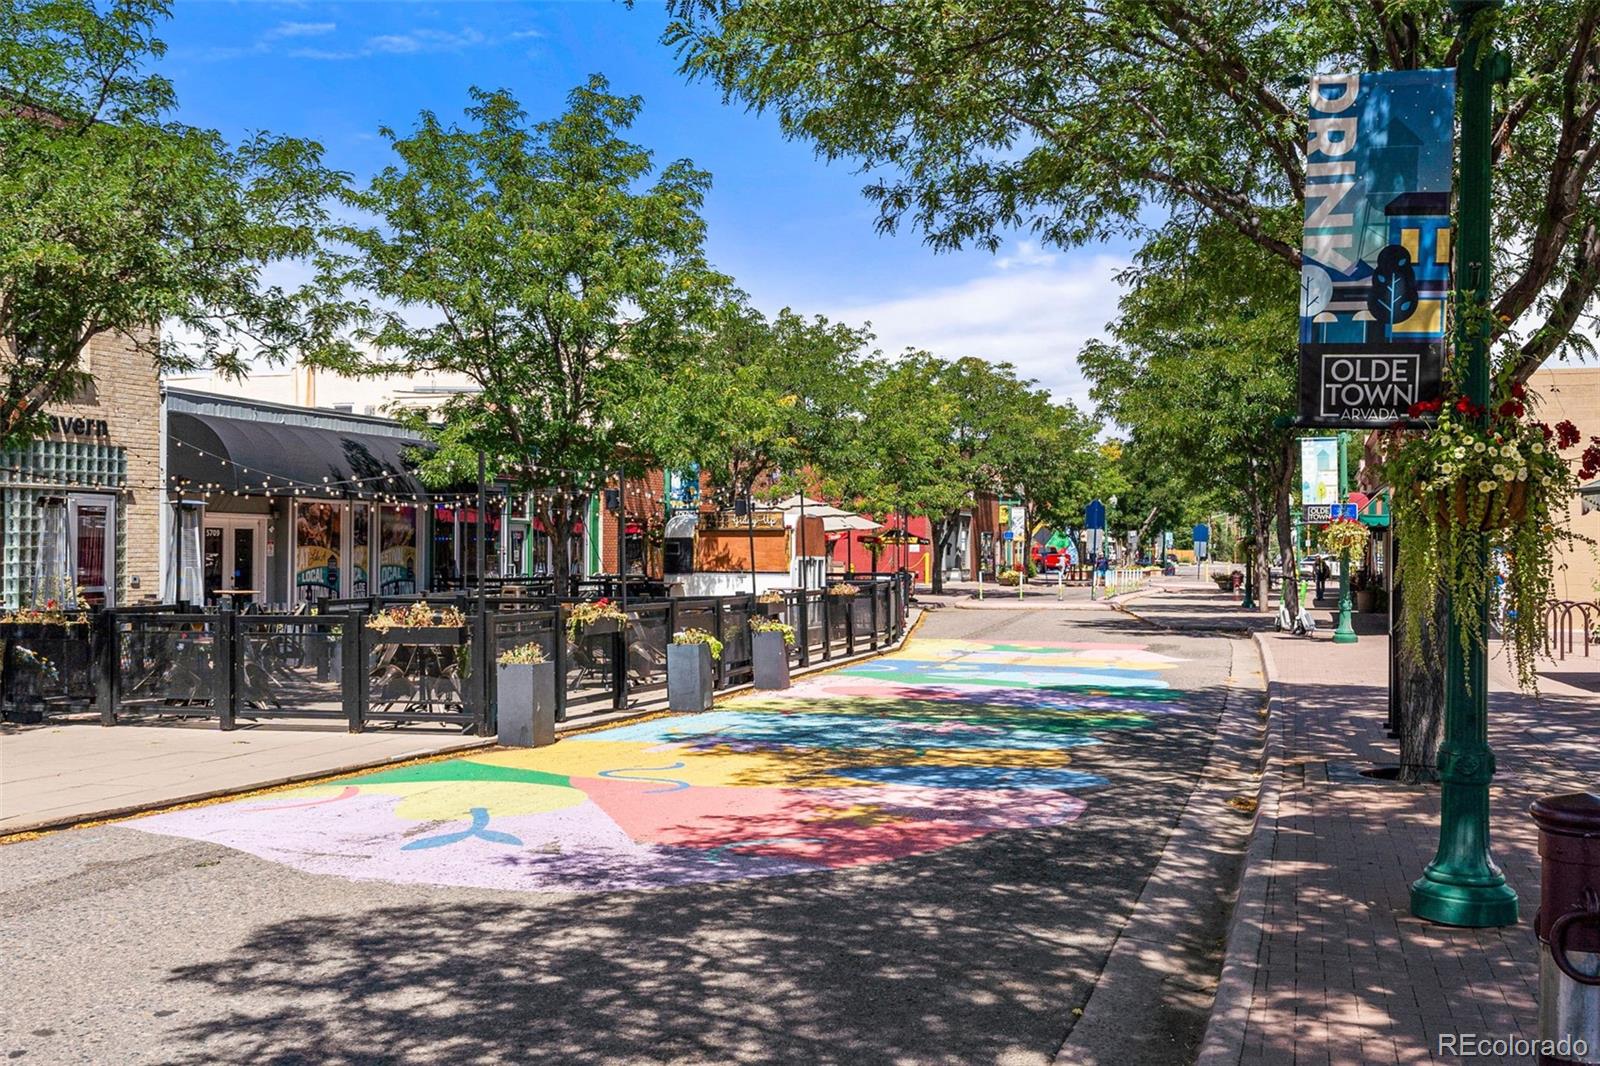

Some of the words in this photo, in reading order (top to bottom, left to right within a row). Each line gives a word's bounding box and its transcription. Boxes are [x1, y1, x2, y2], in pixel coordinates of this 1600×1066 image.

[1303, 75, 1360, 277] DRINK
[1331, 359, 1408, 382] OLDE
[1325, 383, 1413, 406] TOWN
[1341, 408, 1399, 420] ARVADA
[49, 415, 108, 437] avern
[206, 529, 220, 537] 5709
[302, 568, 324, 583] LOCAL
[381, 566, 402, 583] OCAL
